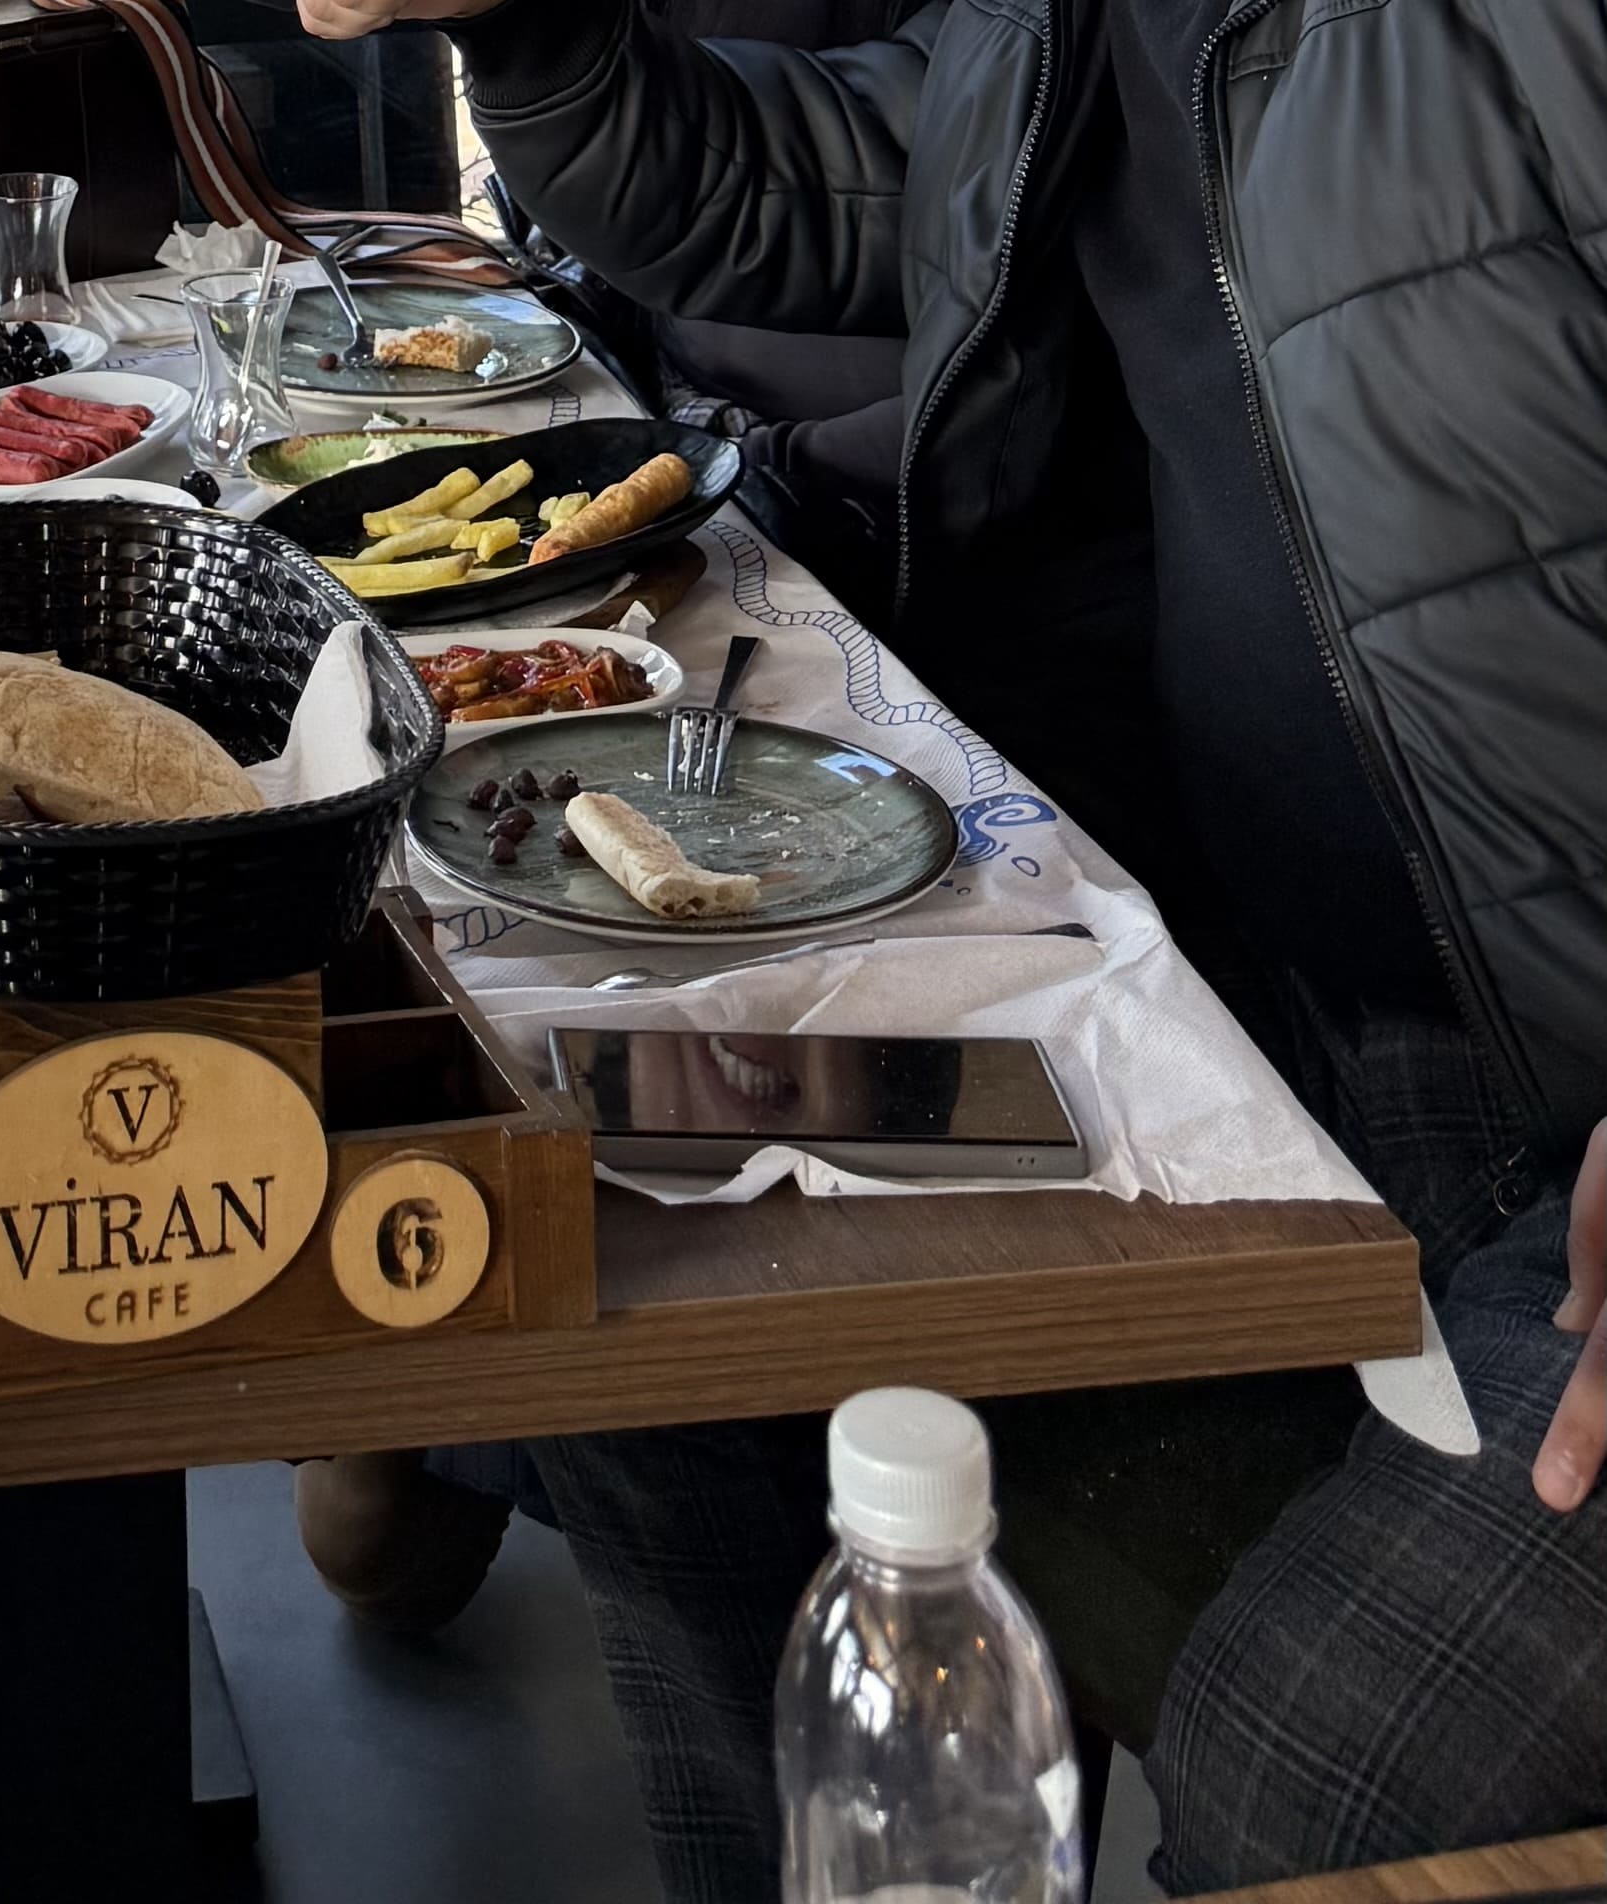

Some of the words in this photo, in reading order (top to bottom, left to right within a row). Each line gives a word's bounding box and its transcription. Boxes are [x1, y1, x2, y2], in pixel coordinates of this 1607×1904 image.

[106, 1082, 160, 1145] V
[375, 1196, 444, 1291] 6
[84, 1281, 192, 1328] CAFE
